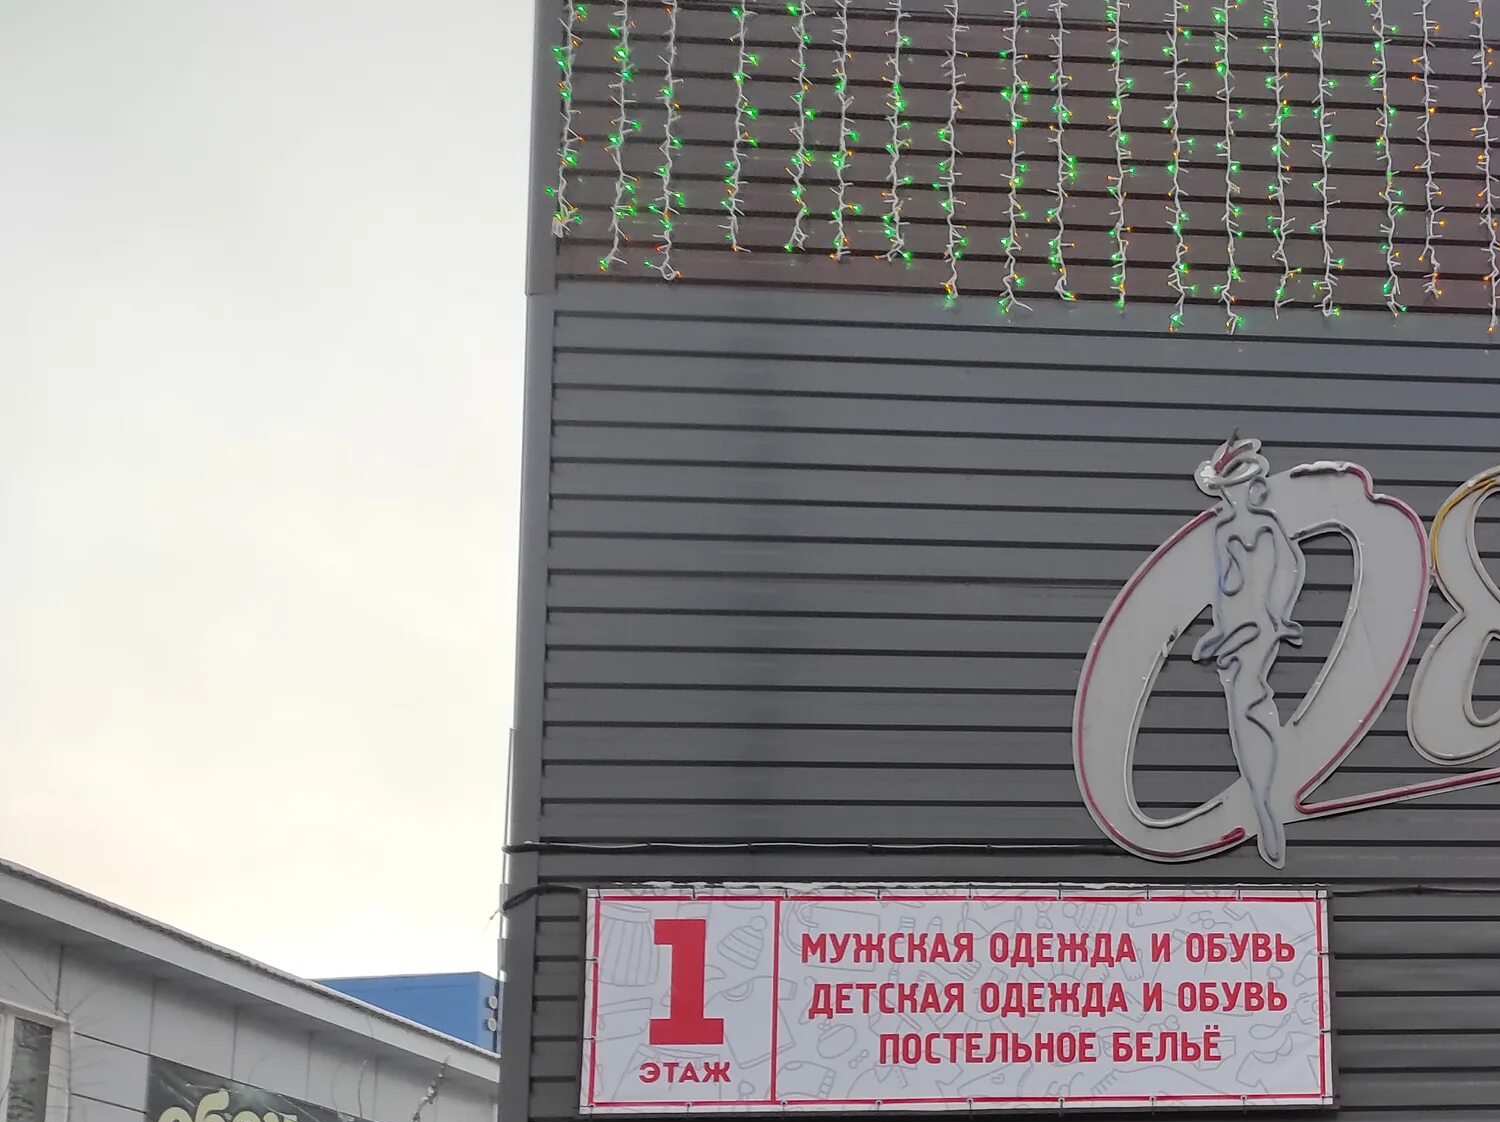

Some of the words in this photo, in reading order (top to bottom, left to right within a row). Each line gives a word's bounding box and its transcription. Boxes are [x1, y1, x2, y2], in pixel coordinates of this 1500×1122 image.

[801, 934, 973, 964] МУЖСКАЯ
[990, 933, 1137, 965] ОДЕЖДА
[1151, 933, 1171, 962] И
[1185, 933, 1295, 962] ОБУВЬ
[649, 919, 724, 1045] 1
[808, 984, 965, 1017] ДЕТСКАЯ
[981, 982, 1129, 1016] ОДЕЖДА
[1143, 983, 1162, 1012] И
[1178, 983, 1287, 1012] ОБУВЬ
[880, 1033, 1097, 1064] ПОСТЕЛЬНОЕ
[1112, 1025, 1221, 1062] БЕЛЬЁ
[638, 1063, 731, 1084] ЭТАЖ
